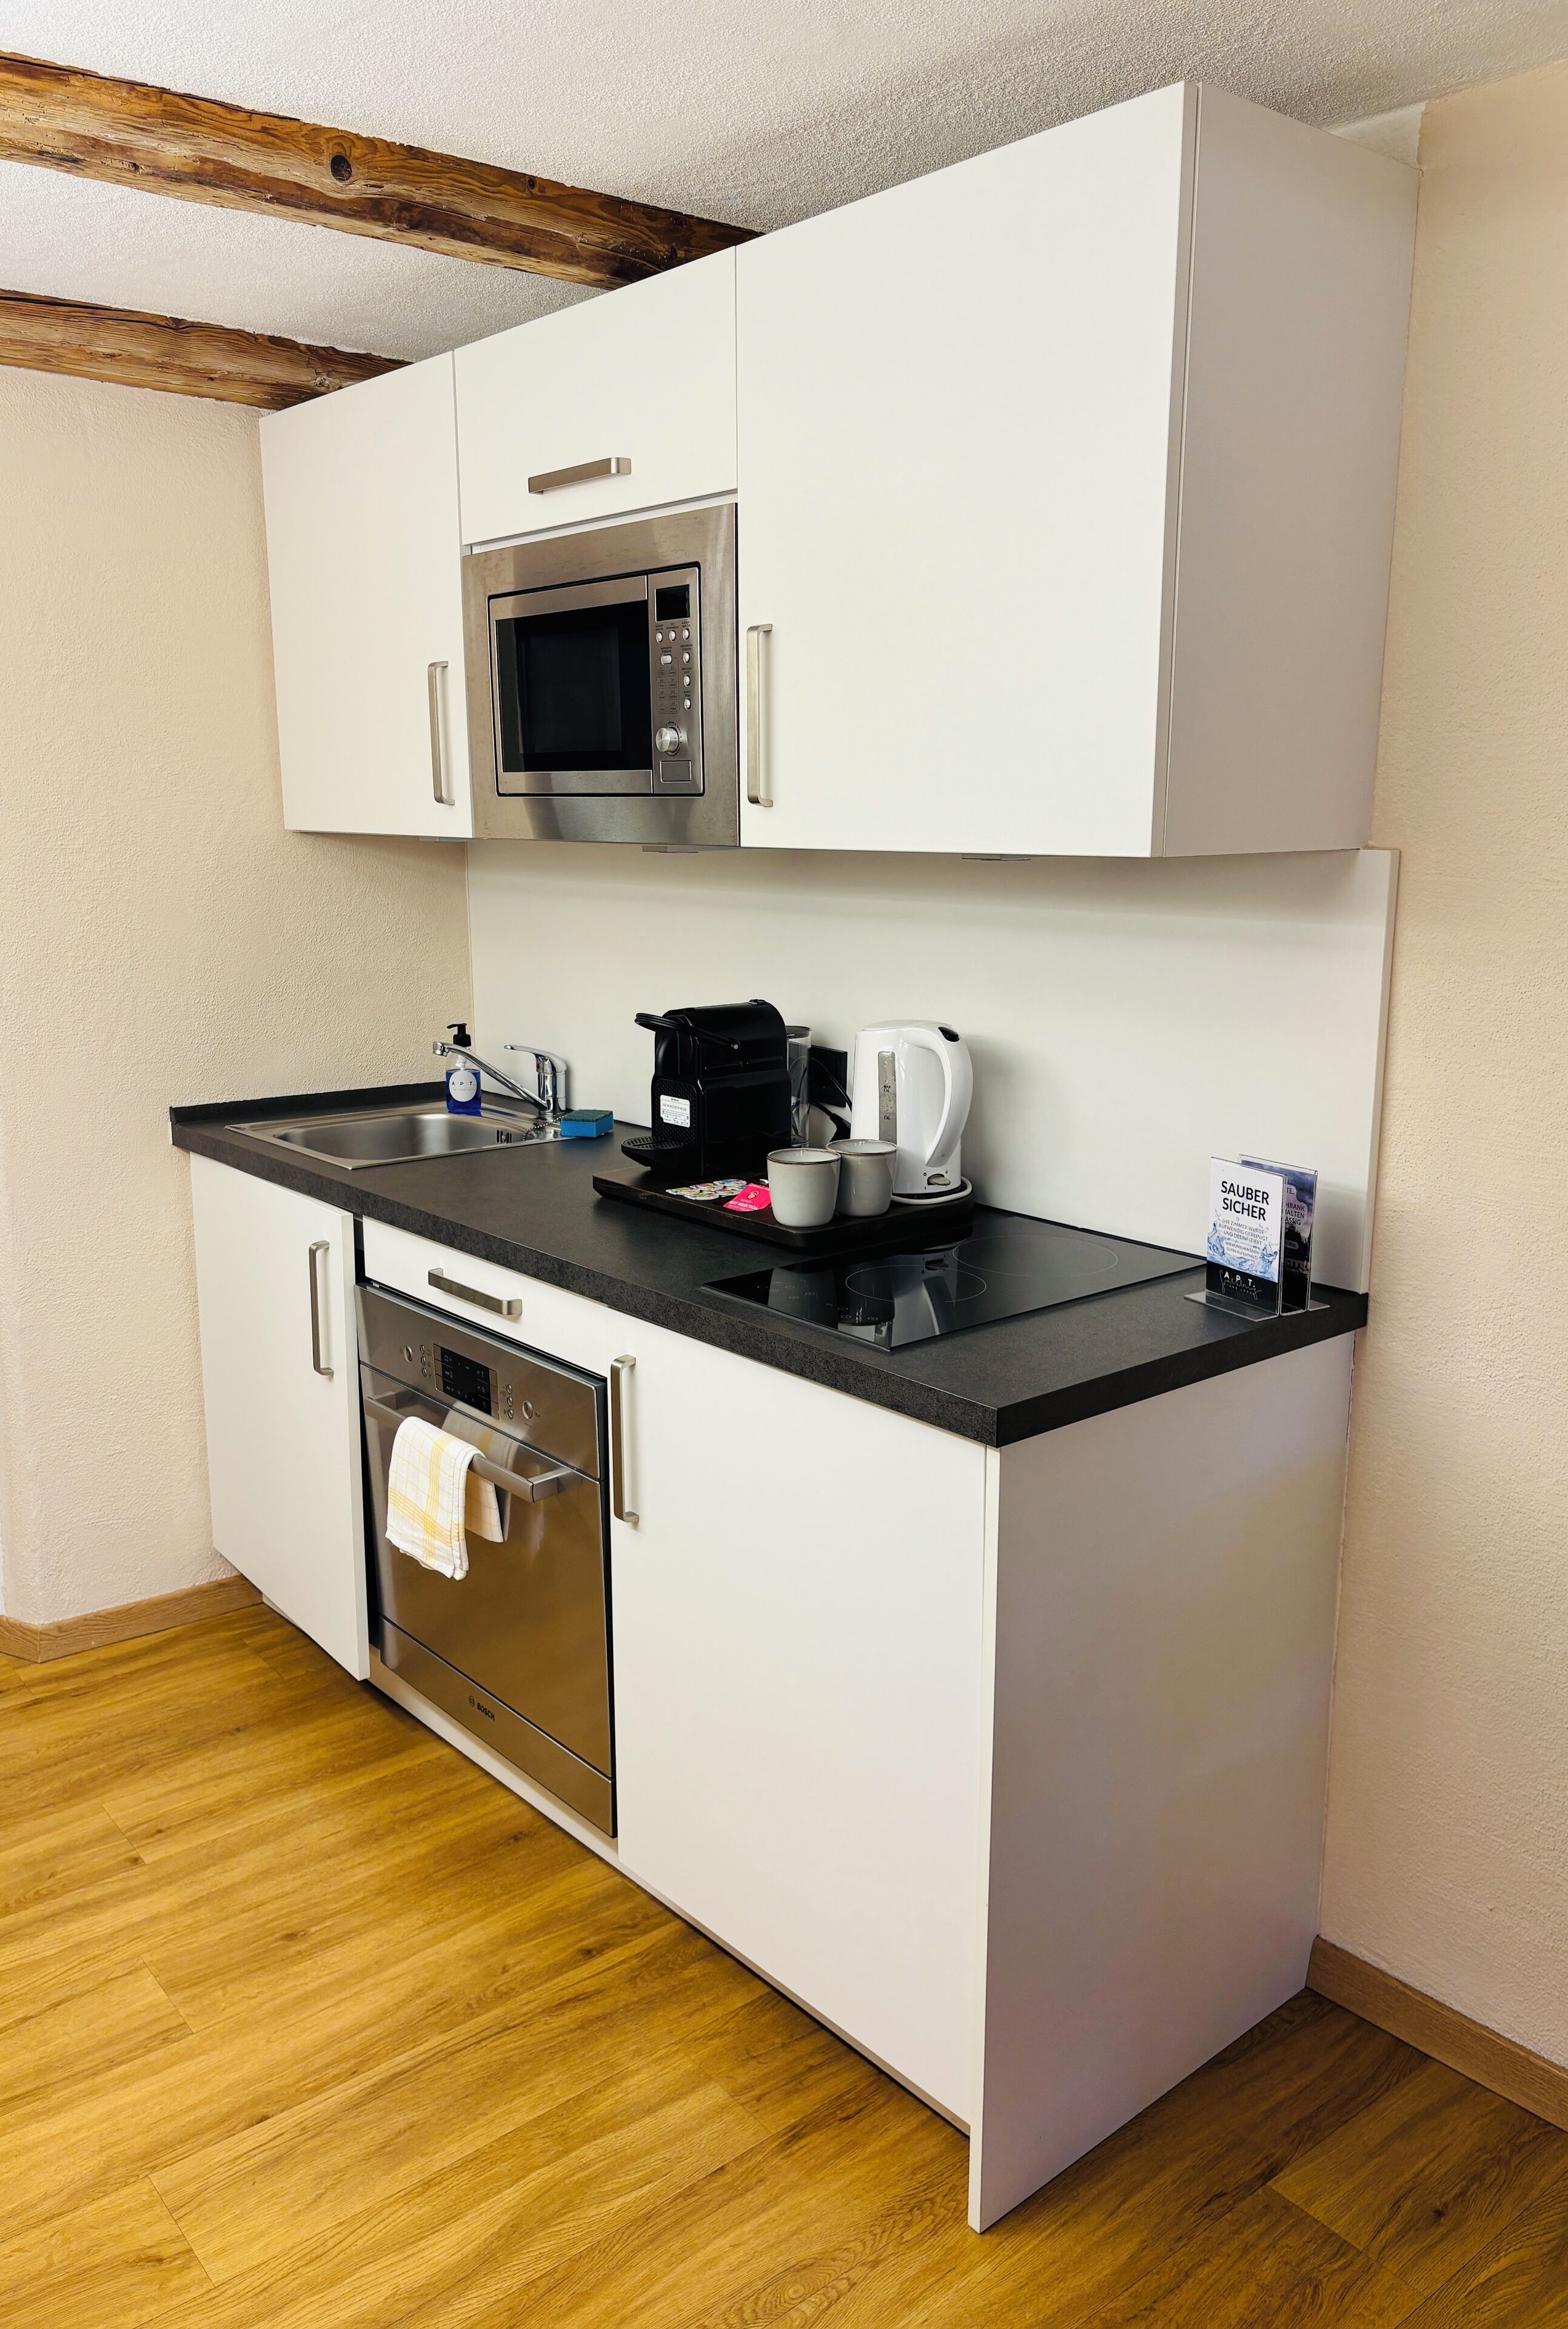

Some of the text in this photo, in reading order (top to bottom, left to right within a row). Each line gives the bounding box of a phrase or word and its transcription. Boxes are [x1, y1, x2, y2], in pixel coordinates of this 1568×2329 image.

[1221, 1181, 1269, 1205] SAUBER
[1222, 1198, 1266, 1221] SICHER
[1286, 1202, 1305, 1212] HRANK
[1218, 1223, 1268, 1242] AUFWENDIG GEREINIGT
[1230, 1220, 1248, 1230] ZIMMER
[1233, 1233, 1262, 1246] DESINFIZIERT
[477, 1702, 495, 1721] BOSCH
